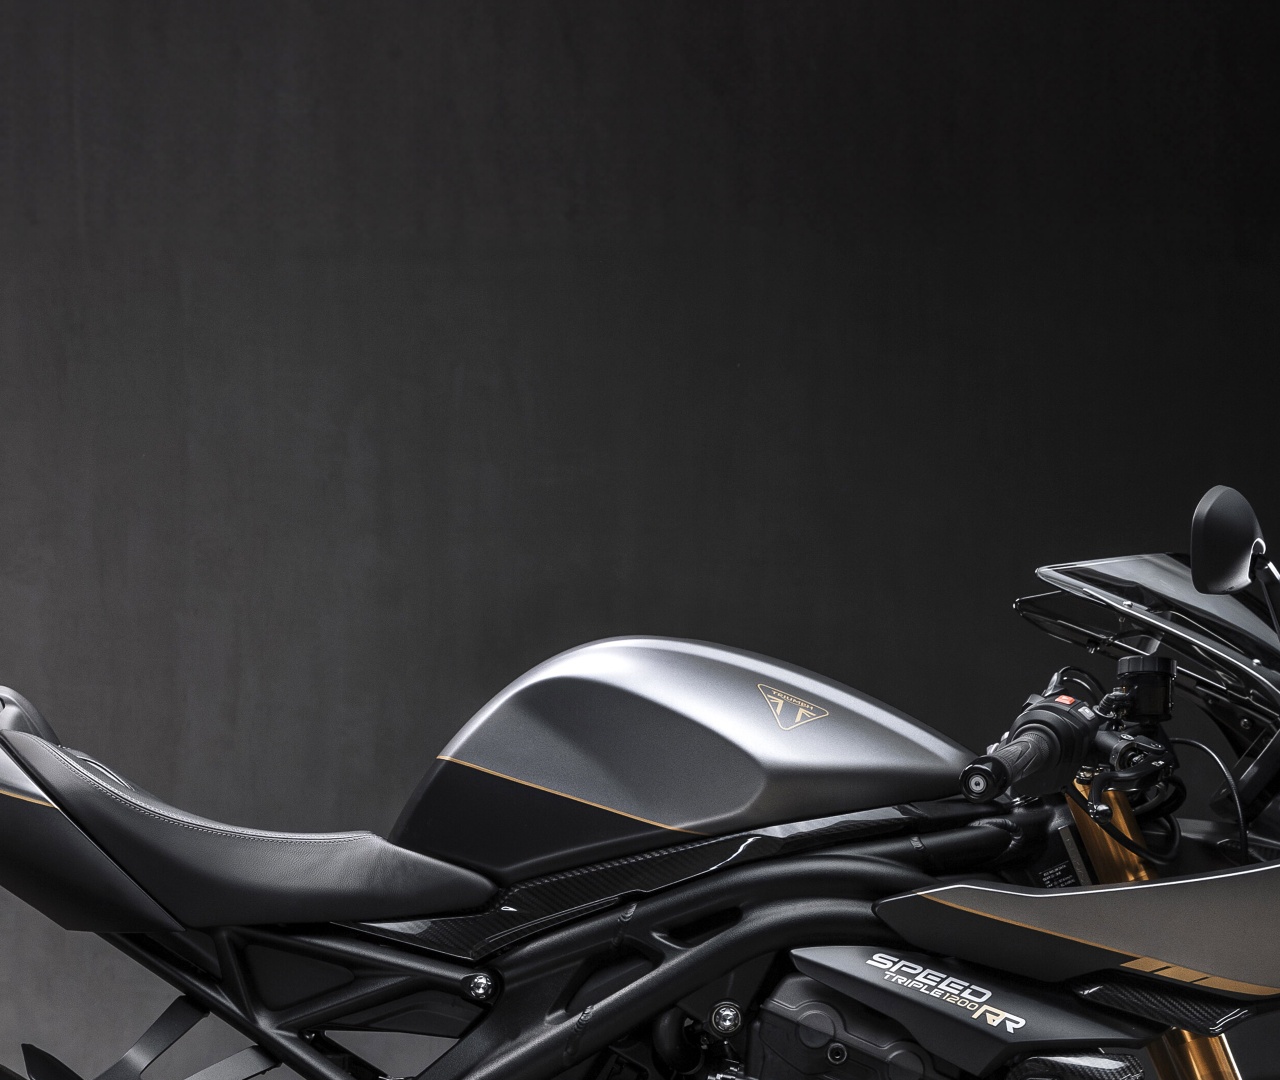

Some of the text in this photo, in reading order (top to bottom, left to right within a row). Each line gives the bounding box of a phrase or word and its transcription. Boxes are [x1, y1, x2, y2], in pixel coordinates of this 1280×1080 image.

[772, 689, 814, 711] TRIUMPH
[865, 953, 993, 1003] SPEED
[883, 971, 979, 1011] TRIPLE 1200
[971, 1004, 1026, 1034] RR
